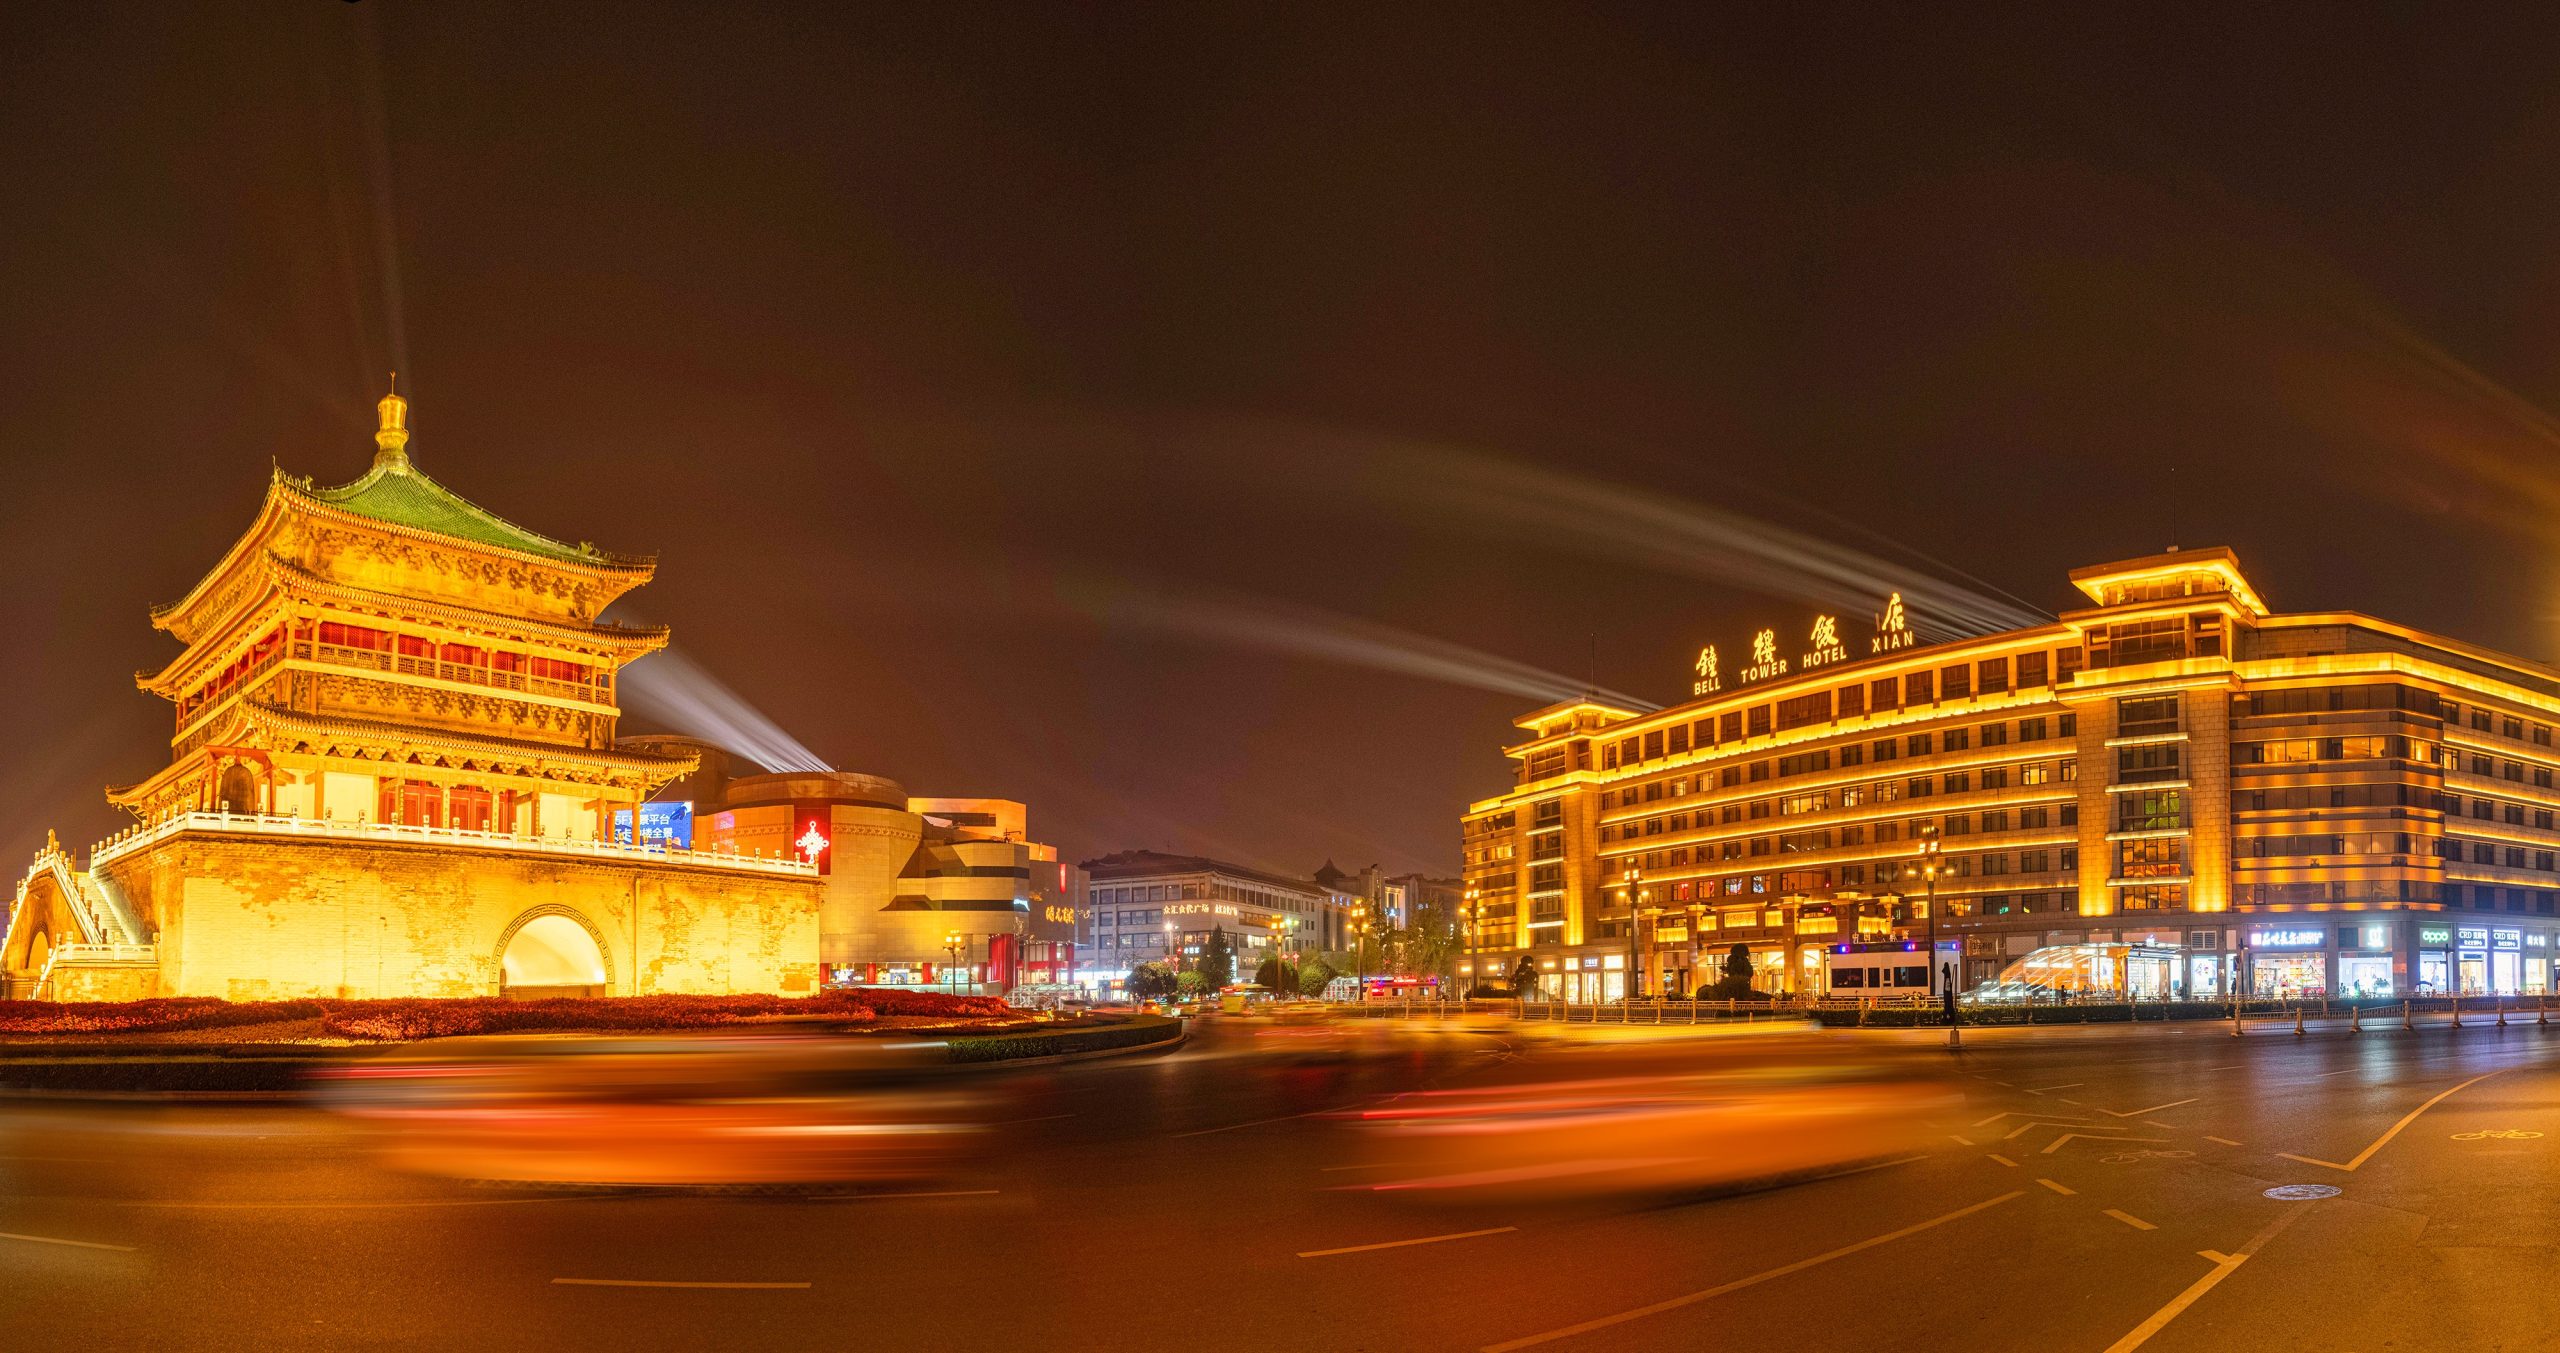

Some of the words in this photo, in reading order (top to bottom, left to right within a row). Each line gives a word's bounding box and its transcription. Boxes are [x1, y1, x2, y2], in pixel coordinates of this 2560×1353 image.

[1694, 677, 1721, 696] BELL
[1741, 660, 1787, 683] TOWER
[1803, 646, 1847, 669] HOTEL
[1872, 630, 1914, 653] XIAN
[2458, 930, 2472, 939] CRD
[2493, 932, 2506, 940] CRD
